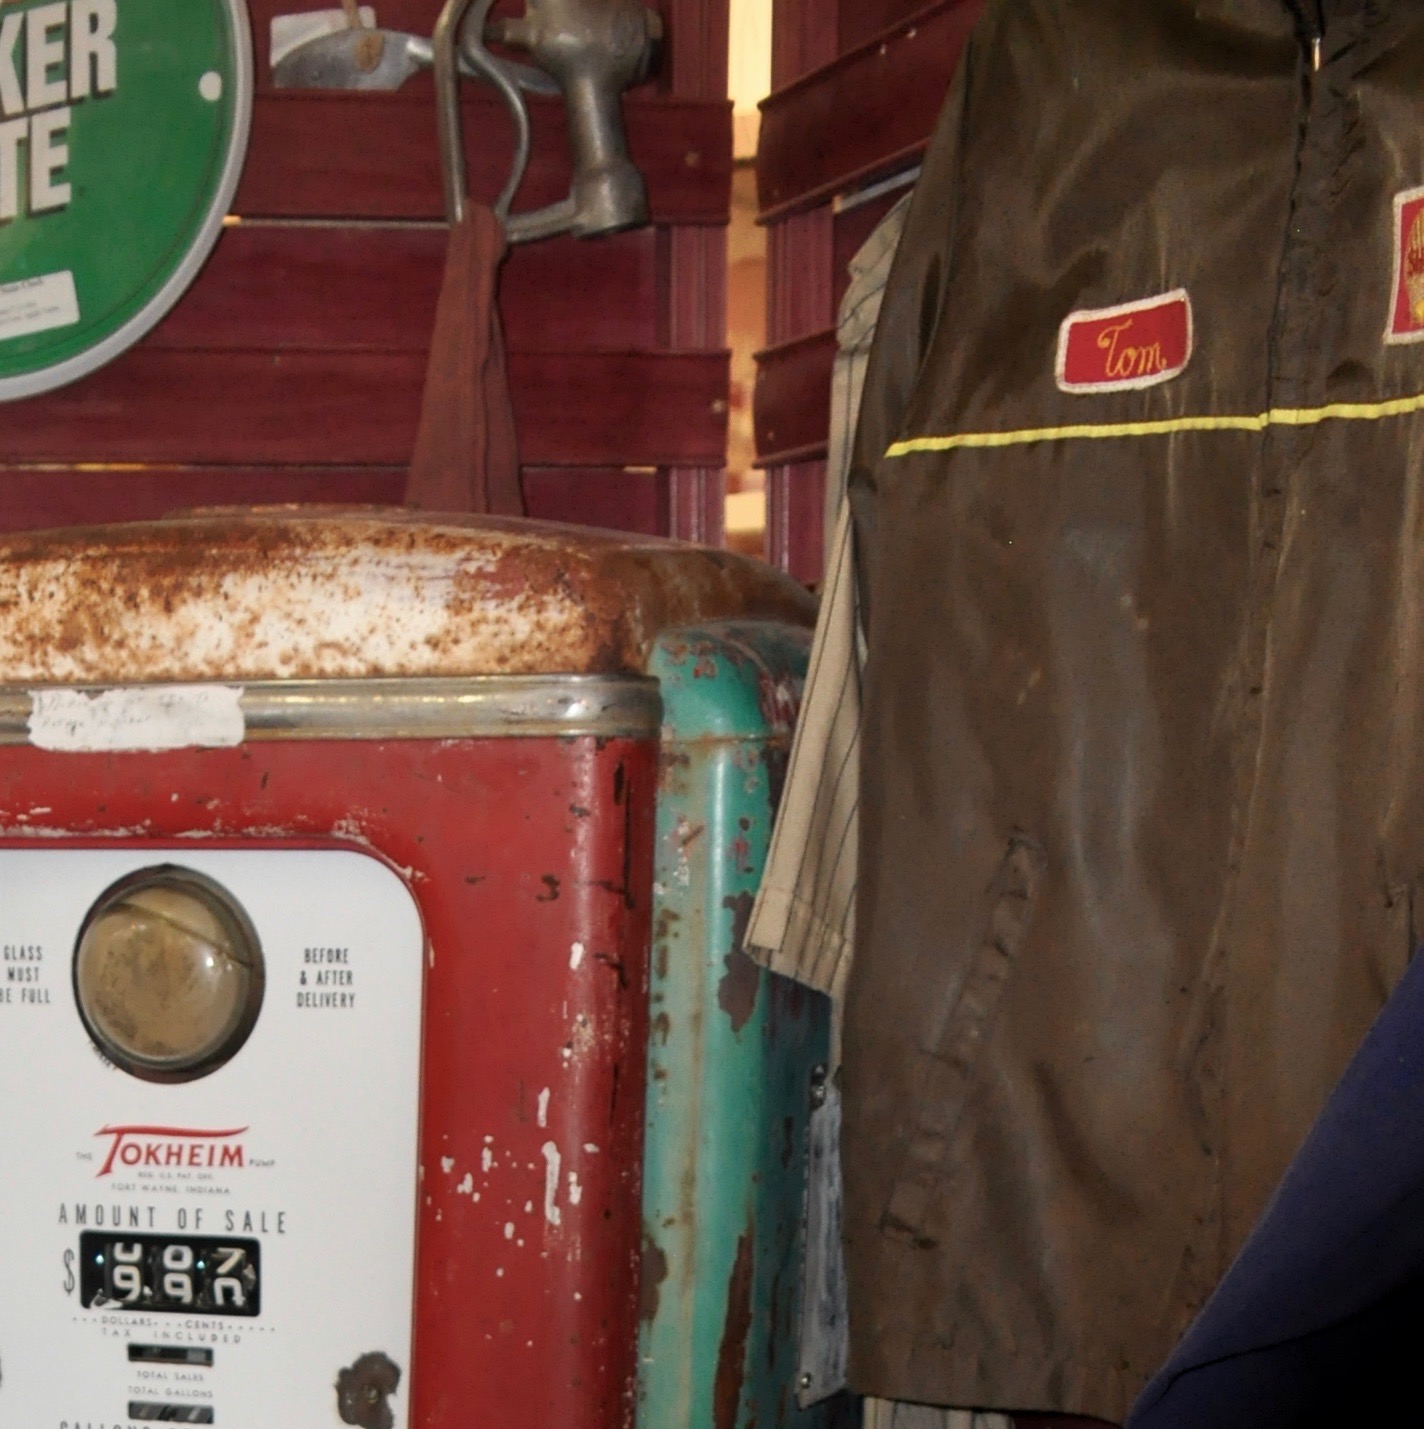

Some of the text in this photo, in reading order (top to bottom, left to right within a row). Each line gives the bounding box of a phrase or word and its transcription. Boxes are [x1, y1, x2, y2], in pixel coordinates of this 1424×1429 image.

[1096, 318, 1168, 378] Tom
[3, 944, 43, 961] GLASS
[303, 946, 350, 964] BEFORE
[7, 966, 39, 982] MUST
[299, 969, 353, 986] & AFTER
[21, 987, 51, 1004] FULL
[296, 991, 356, 1008] DELIVERY
[92, 1123, 251, 1179] TOKHEIM
[110, 1182, 136, 1192] FORT
[185, 1185, 232, 1195] INDIANA
[58, 1202, 287, 1235] AMOUNT OF SALE
[153, 1330, 242, 1344] INCLUDED
[136, 1370, 169, 1381] TOTAL
[127, 1385, 214, 1398] TOTAL GALLONS
